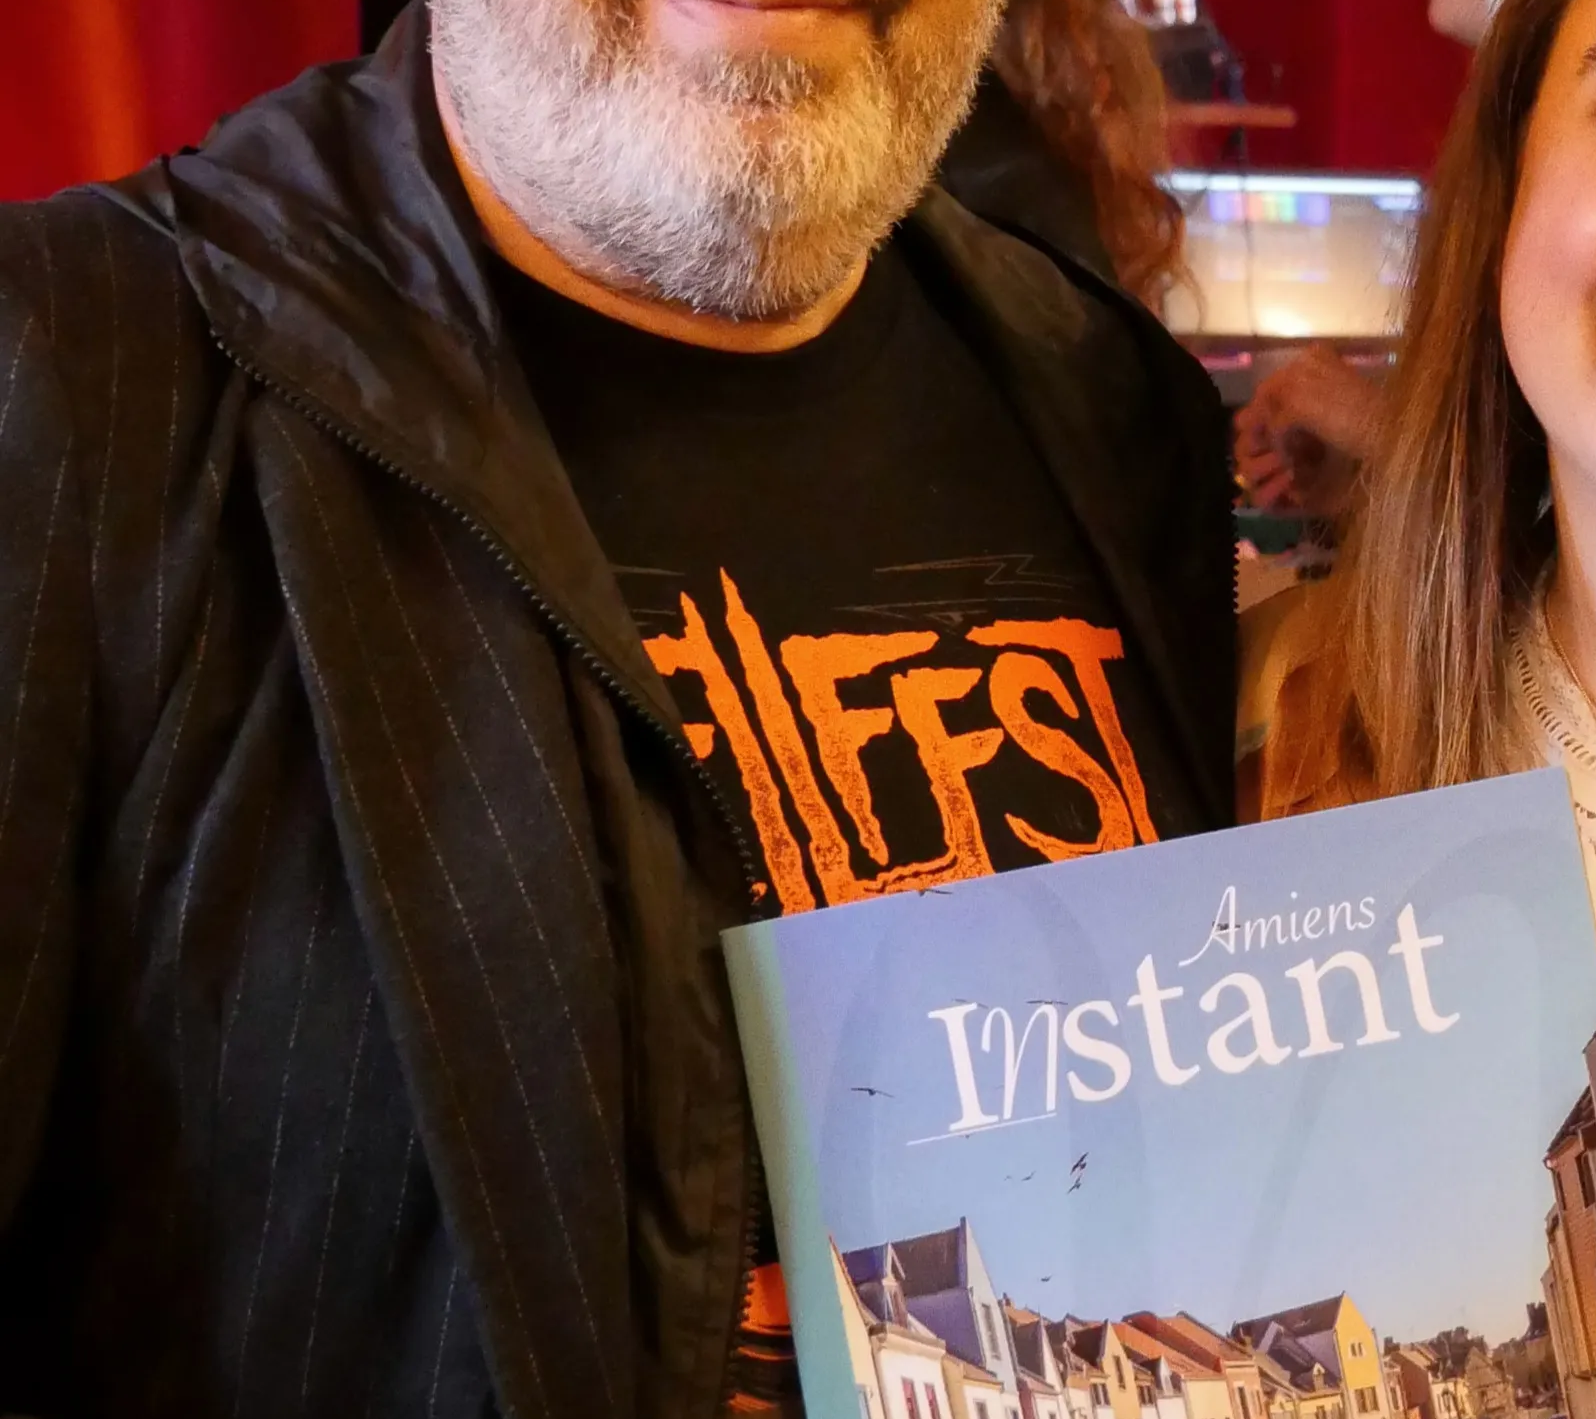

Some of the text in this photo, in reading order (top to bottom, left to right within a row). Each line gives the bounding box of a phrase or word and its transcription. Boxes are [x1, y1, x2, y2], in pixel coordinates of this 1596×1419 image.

[643, 567, 1159, 918] LLFEST
[927, 902, 1461, 1132] Instant
[1178, 885, 1377, 967] Amiens
